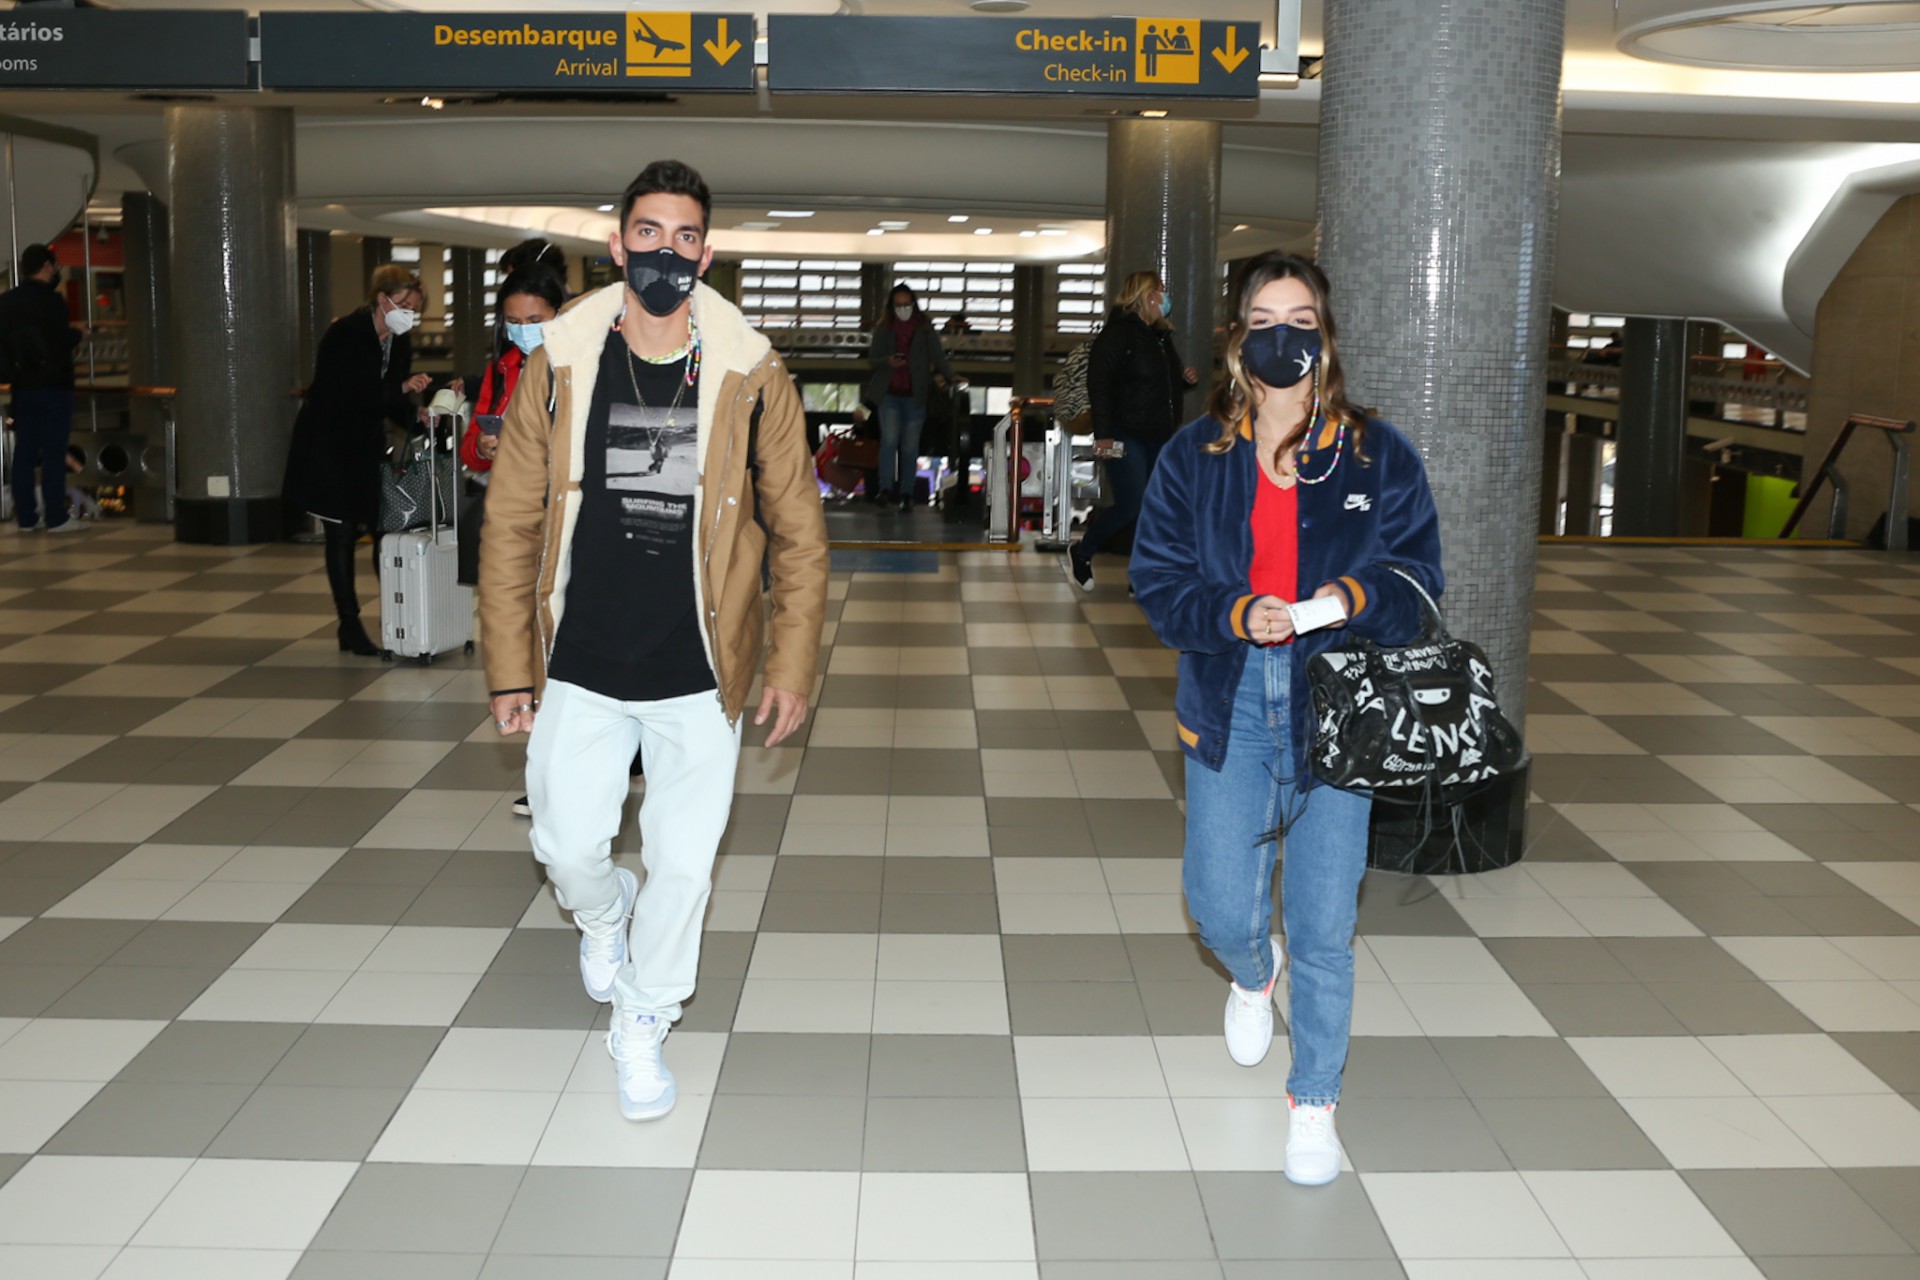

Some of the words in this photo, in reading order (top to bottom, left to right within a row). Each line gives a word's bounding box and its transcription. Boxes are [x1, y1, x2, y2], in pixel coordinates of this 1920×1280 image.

[434, 23, 618, 50] Desembarque
[1015, 29, 1128, 52] Check-in
[0, 58, 38, 71] oms
[555, 58, 618, 76] Arrival
[1044, 64, 1127, 82] Check-in
